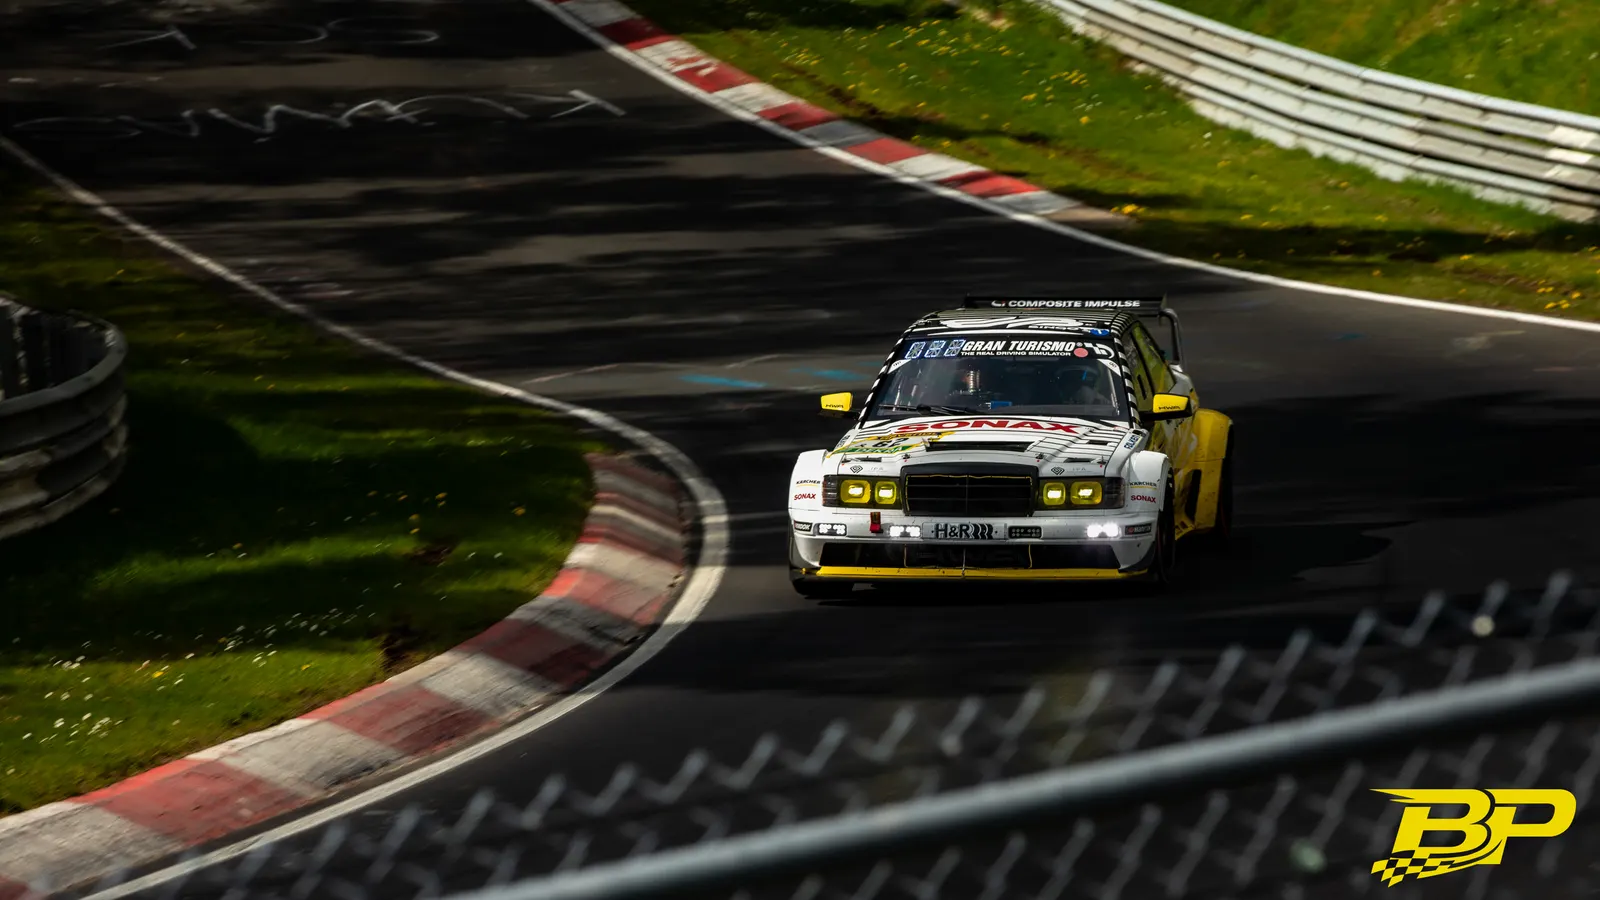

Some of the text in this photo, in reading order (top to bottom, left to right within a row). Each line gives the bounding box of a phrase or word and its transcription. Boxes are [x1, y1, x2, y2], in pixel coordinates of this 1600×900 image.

[1008, 300, 1141, 308] COMPOSITE IMPULSE
[962, 341, 1076, 352] GRAN TURISMO
[897, 420, 1081, 434] SONAX
[794, 493, 817, 501] SONAX
[1131, 495, 1157, 504] SONAX
[935, 523, 976, 540] H&R
